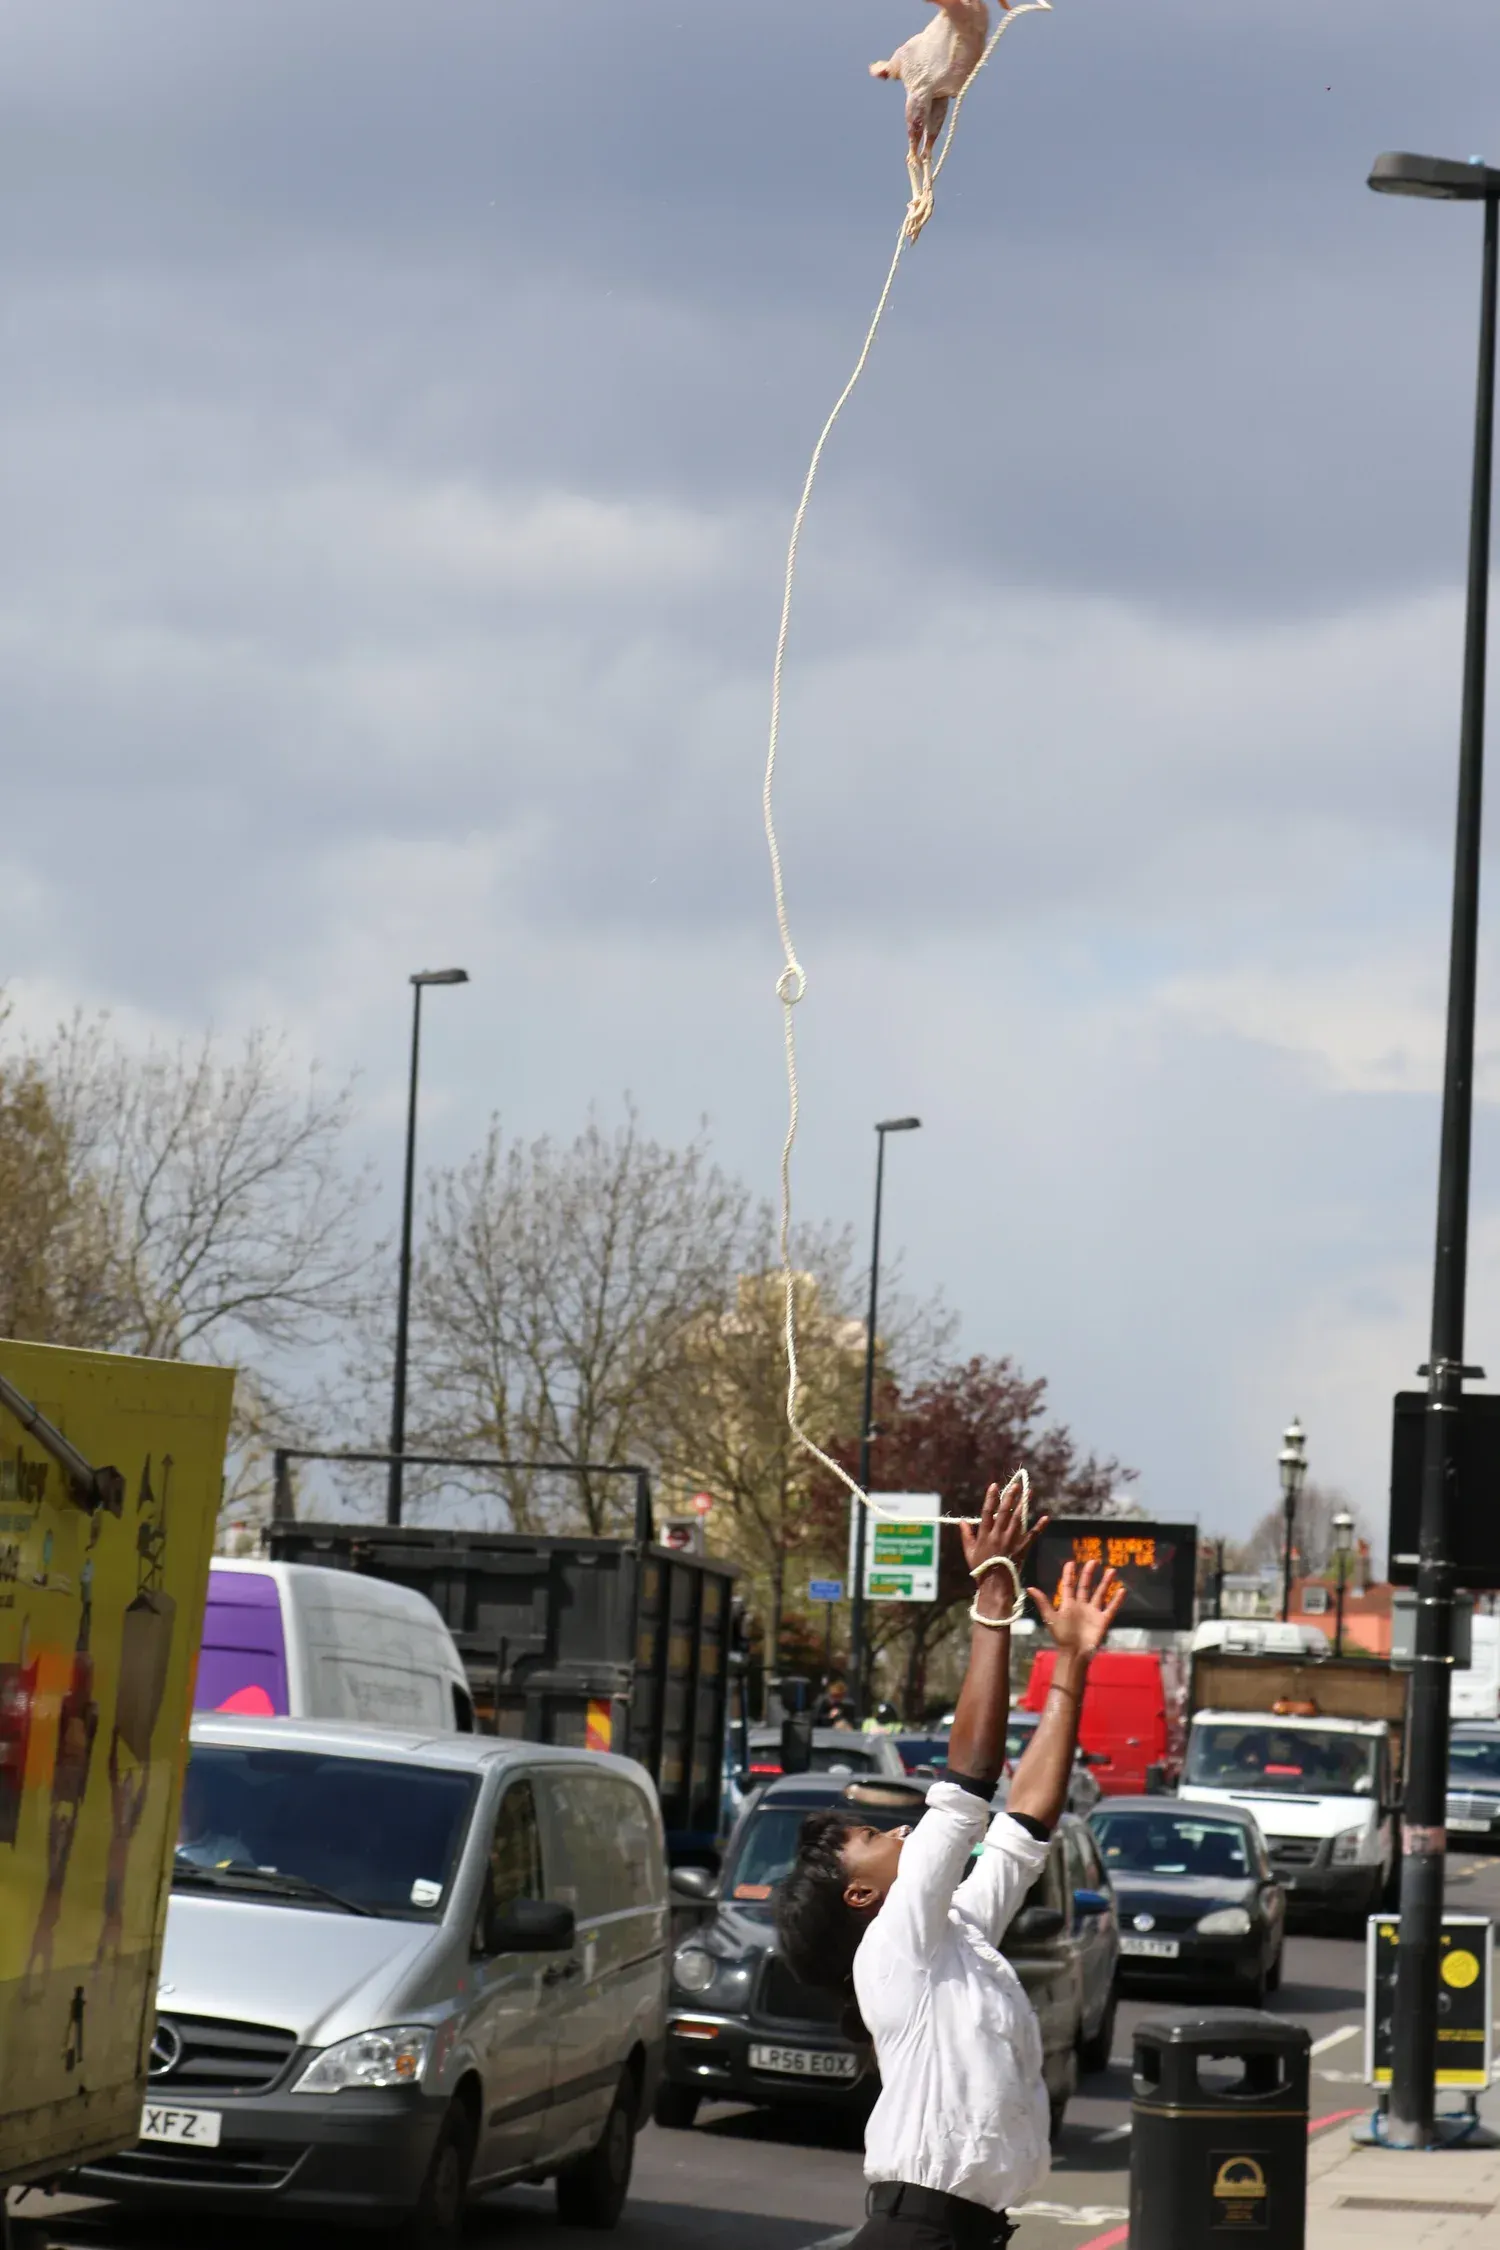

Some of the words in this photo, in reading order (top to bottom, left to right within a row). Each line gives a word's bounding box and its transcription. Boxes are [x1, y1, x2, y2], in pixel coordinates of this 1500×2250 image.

[757, 2050, 805, 2071] LR56
[810, 2054, 850, 2075] EOX
[146, 2109, 198, 2138] XFZ
